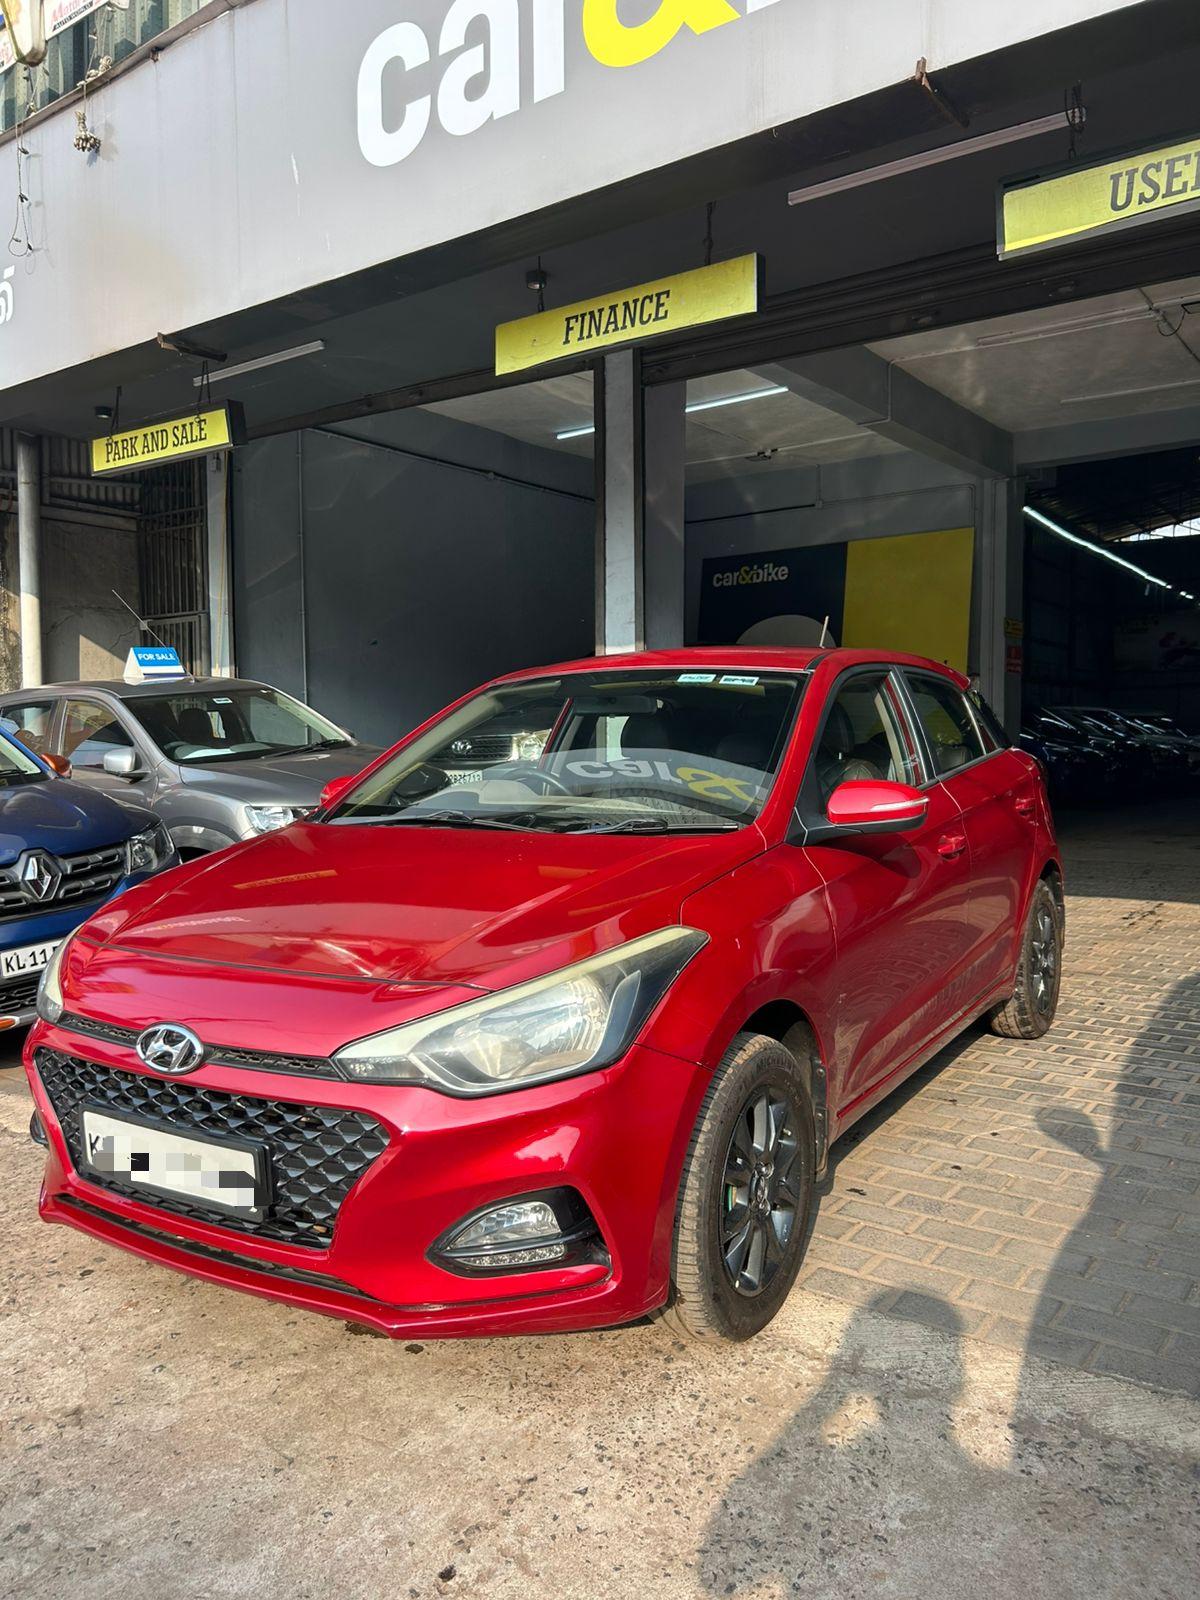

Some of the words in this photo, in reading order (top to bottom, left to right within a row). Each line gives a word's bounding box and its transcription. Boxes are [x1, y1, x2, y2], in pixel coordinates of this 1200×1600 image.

[357, 0, 783, 167] car
[563, 290, 671, 346] FINANCE
[105, 436, 139, 463] PARK
[142, 428, 169, 455] AND
[172, 418, 208, 448] SALE
[712, 563, 789, 587] car&bike
[138, 653, 155, 661] FOR
[155, 653, 176, 661] SALE
[5, 946, 57, 973] KL11
